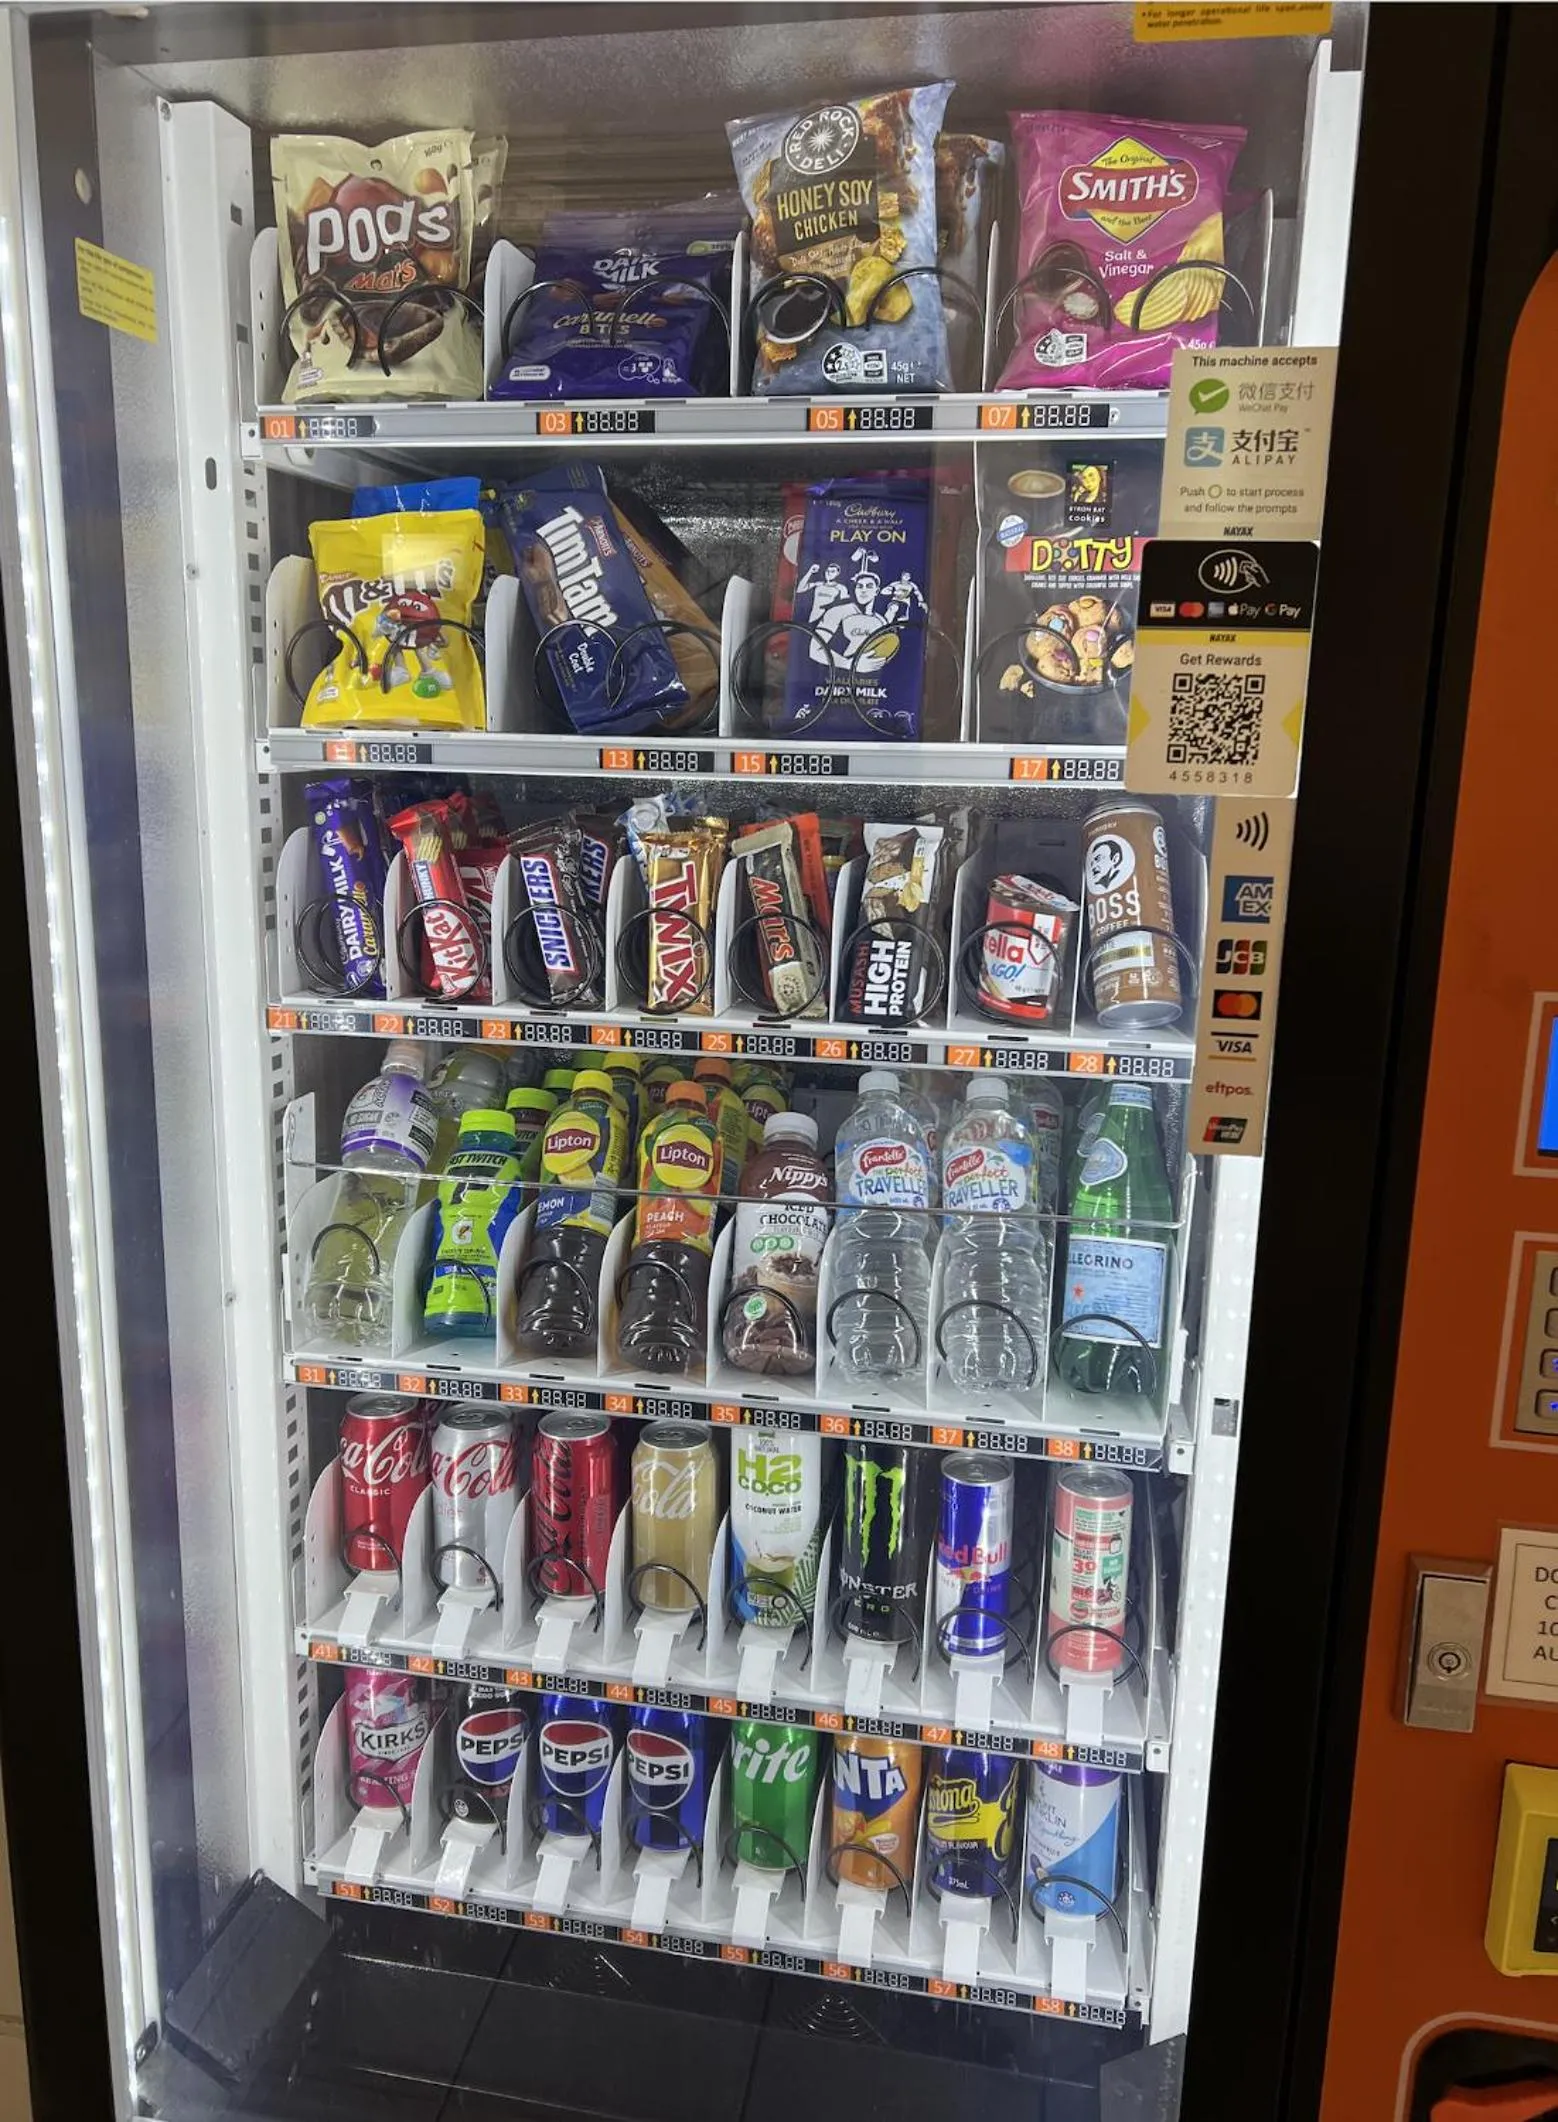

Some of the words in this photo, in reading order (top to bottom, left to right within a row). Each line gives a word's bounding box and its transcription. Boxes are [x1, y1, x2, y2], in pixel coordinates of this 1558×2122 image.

[789, 119, 814, 153] RED
[819, 110, 856, 138] ROCK
[799, 147, 844, 171] DELI
[1067, 168, 1187, 202] SMITH'S
[776, 181, 836, 221] HONEY
[838, 180, 873, 207] SOY
[793, 209, 858, 241] CHICKEN
[1104, 250, 1132, 262] Salt
[1135, 249, 1148, 261] &
[1099, 263, 1154, 279] Vinegar
[1192, 356, 1216, 367] This
[1218, 356, 1269, 367] machine
[1271, 356, 1318, 369] accepts
[896, 373, 916, 384] NET
[545, 415, 567, 432] 03
[816, 410, 839, 428] 05
[987, 406, 1011, 426] 07
[270, 420, 289, 437] 01
[1231, 428, 1299, 453] 支付宝
[1231, 454, 1297, 466] ALIPAY
[1180, 486, 1205, 497] Push
[1226, 487, 1234, 497] to
[1235, 487, 1262, 497] start
[1265, 488, 1305, 499] process
[1183, 503, 1201, 513] and
[1203, 503, 1232, 513] follow
[1234, 503, 1250, 513] the
[1252, 503, 1298, 516] prompts
[829, 529, 874, 543] PLAY
[876, 530, 907, 544] ON
[1240, 603, 1261, 618] Pay
[1279, 604, 1302, 619] Pay
[1180, 653, 1203, 666] Get
[1206, 654, 1262, 667] Rewards
[855, 687, 888, 698] MILK
[608, 750, 628, 768] 13
[740, 755, 761, 773] 15
[1021, 759, 1040, 777] 17
[1168, 771, 1253, 784] 4558318
[1087, 889, 1141, 931] BOSS
[652, 860, 698, 1004] TWIX
[1096, 918, 1131, 938] COFFEE
[1215, 951, 1265, 966] JCB
[864, 939, 896, 1017] HIGH
[888, 940, 913, 1018] PROTEIN
[274, 1013, 291, 1028] 21
[380, 1017, 399, 1032] 22
[486, 1024, 506, 1039] 23
[598, 1029, 617, 1044] 24
[708, 1035, 728, 1050] 25
[822, 1041, 842, 1057] 26
[1215, 1040, 1253, 1054] VISA
[954, 1050, 975, 1065] 27
[1075, 1055, 1099, 1072] 28
[547, 1133, 592, 1150] Lipton
[466, 1153, 508, 1165] TWITCH
[660, 1146, 707, 1167] Lipton
[769, 1165, 829, 1190] Nippy's
[646, 1211, 684, 1223] PEACH
[301, 1364, 320, 1381] 31
[403, 1375, 421, 1391] 32
[504, 1385, 523, 1401] 33
[609, 1396, 628, 1412] 34
[715, 1405, 735, 1422] 35
[824, 1418, 845, 1434] 36
[938, 1428, 958, 1444] 37
[1054, 1440, 1073, 1457] 38
[738, 1448, 802, 1482] H2
[972, 1541, 1007, 1565] Bull
[412, 1657, 430, 1671] 42
[510, 1672, 529, 1685] 43
[609, 1685, 629, 1699] 44
[713, 1699, 733, 1714] 45
[818, 1713, 839, 1728] 46
[360, 1720, 427, 1750] KIRKS
[927, 1727, 947, 1741] 47
[542, 1743, 610, 1767] PEPSI
[1039, 1741, 1059, 1756] 48
[628, 1752, 690, 1780] PEPSI
[431, 1899, 450, 1912] 52
[626, 1930, 644, 1944] 54
[827, 1963, 847, 1978] 56
[933, 1982, 952, 1995] 57
[1040, 1998, 1062, 2012] 58
